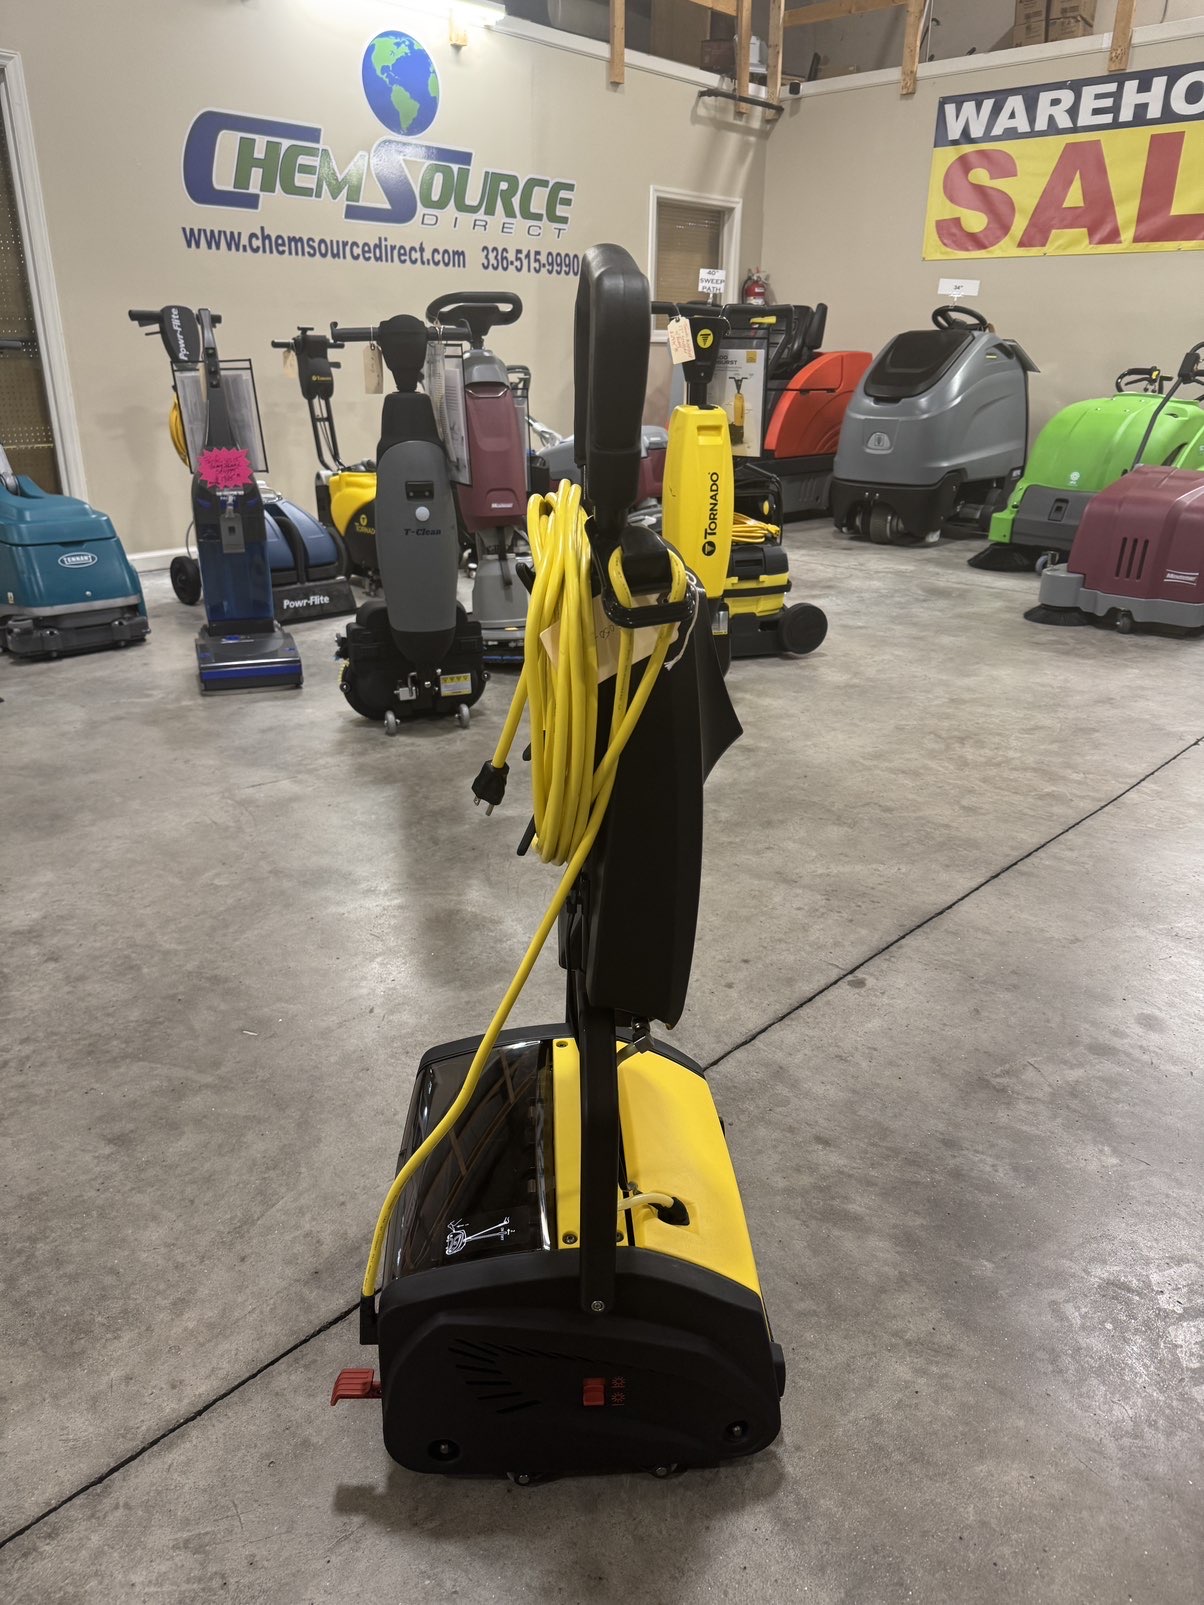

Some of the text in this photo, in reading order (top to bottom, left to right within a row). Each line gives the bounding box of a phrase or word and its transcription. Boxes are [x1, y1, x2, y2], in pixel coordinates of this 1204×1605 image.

[421, 213, 566, 239] DIRECT
[181, 226, 580, 277] www.chemsourcedirect.com 336-515-9990
[702, 286, 721, 294] PATH
[171, 307, 189, 361] Powr-Flite
[704, 472, 719, 540] TORNADO
[403, 528, 441, 536] T-Clean
[283, 594, 330, 609] Powr-Flite
